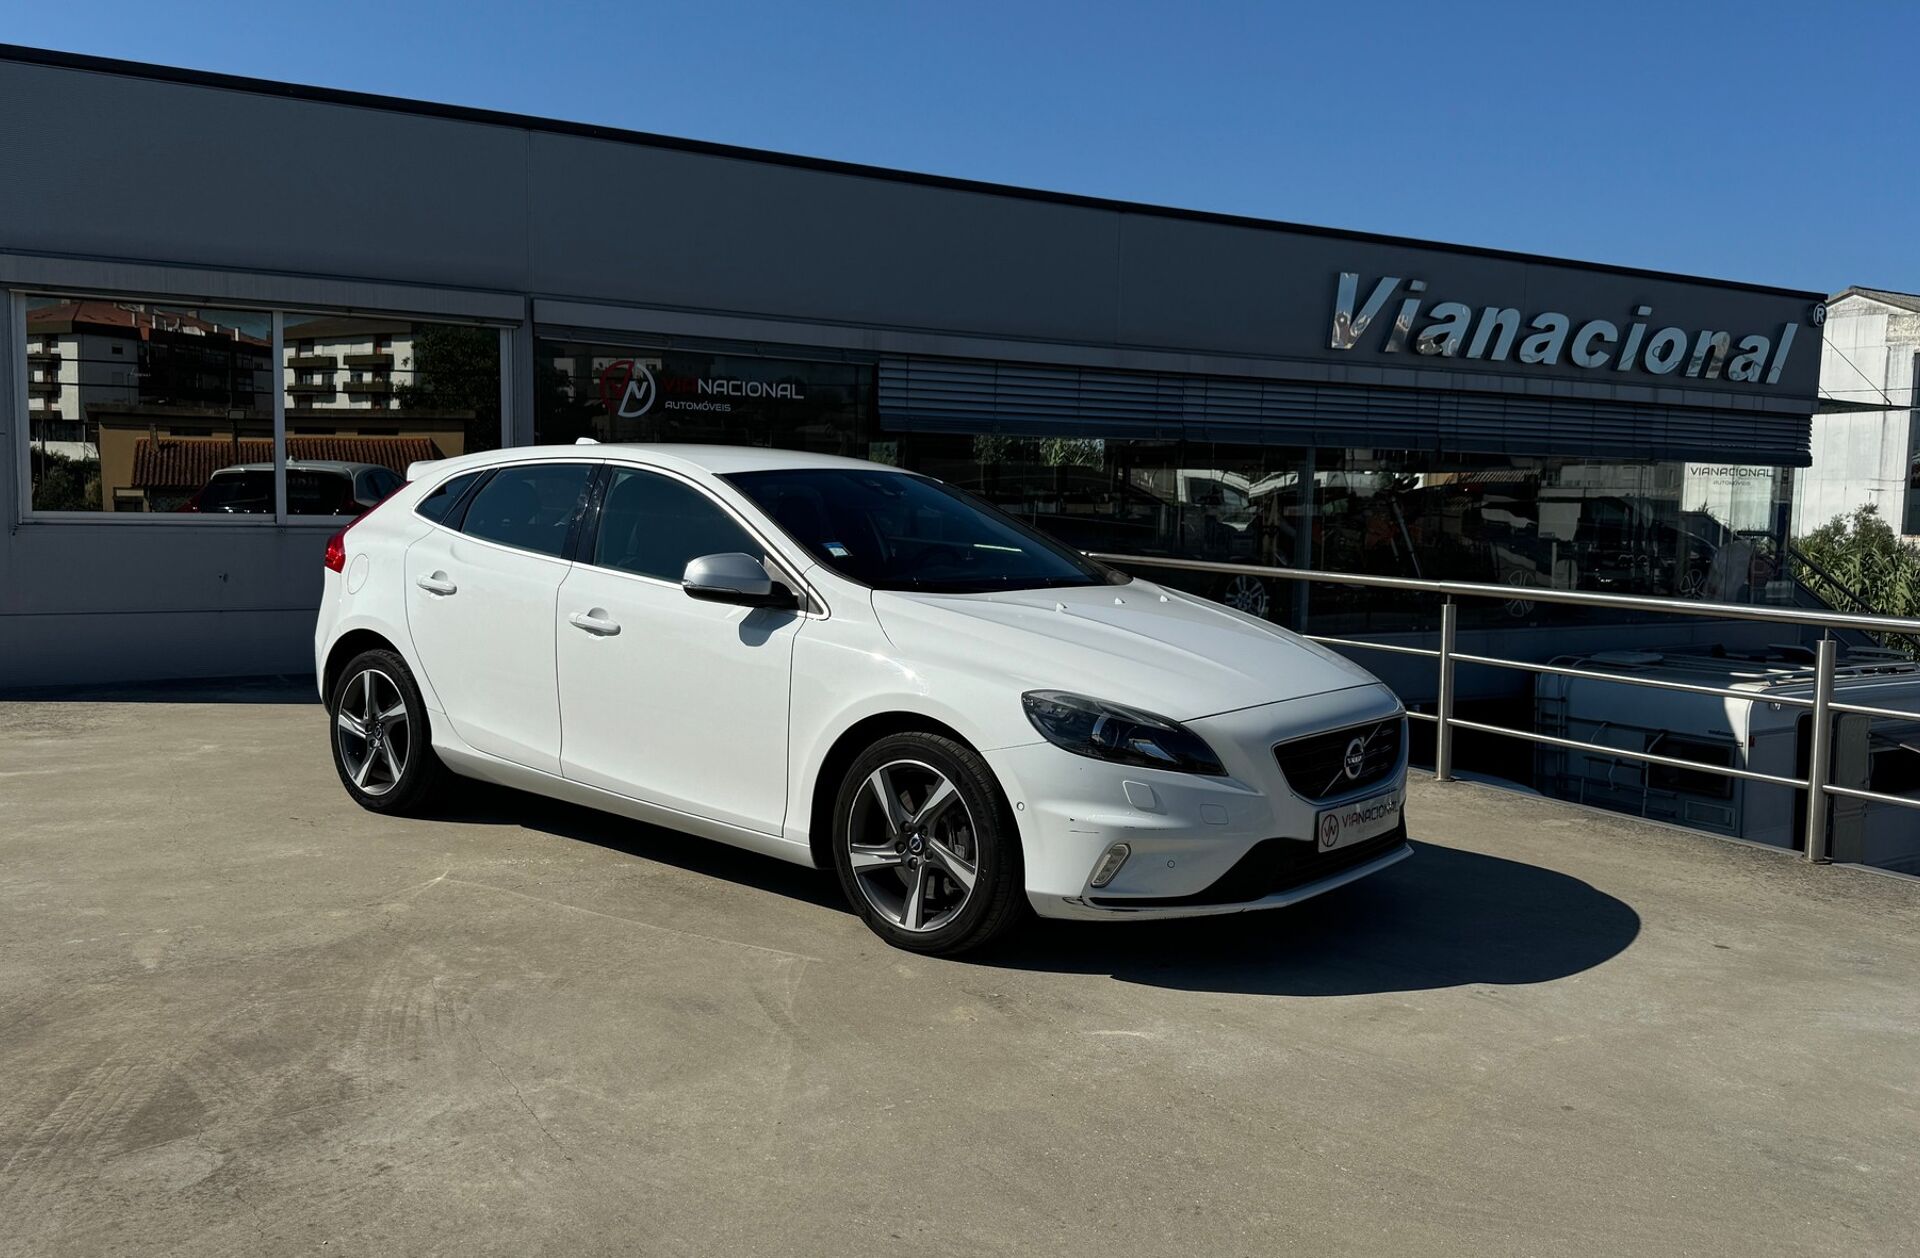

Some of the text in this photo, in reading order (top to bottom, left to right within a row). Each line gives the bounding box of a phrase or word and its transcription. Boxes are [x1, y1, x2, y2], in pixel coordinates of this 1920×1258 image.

[1329, 272, 1798, 385] Vianacional
[662, 378, 805, 400] VIANACIONAL
[664, 400, 732, 412] AUTOMÓVEIS
[1690, 466, 1774, 478] VIANACIONAL
